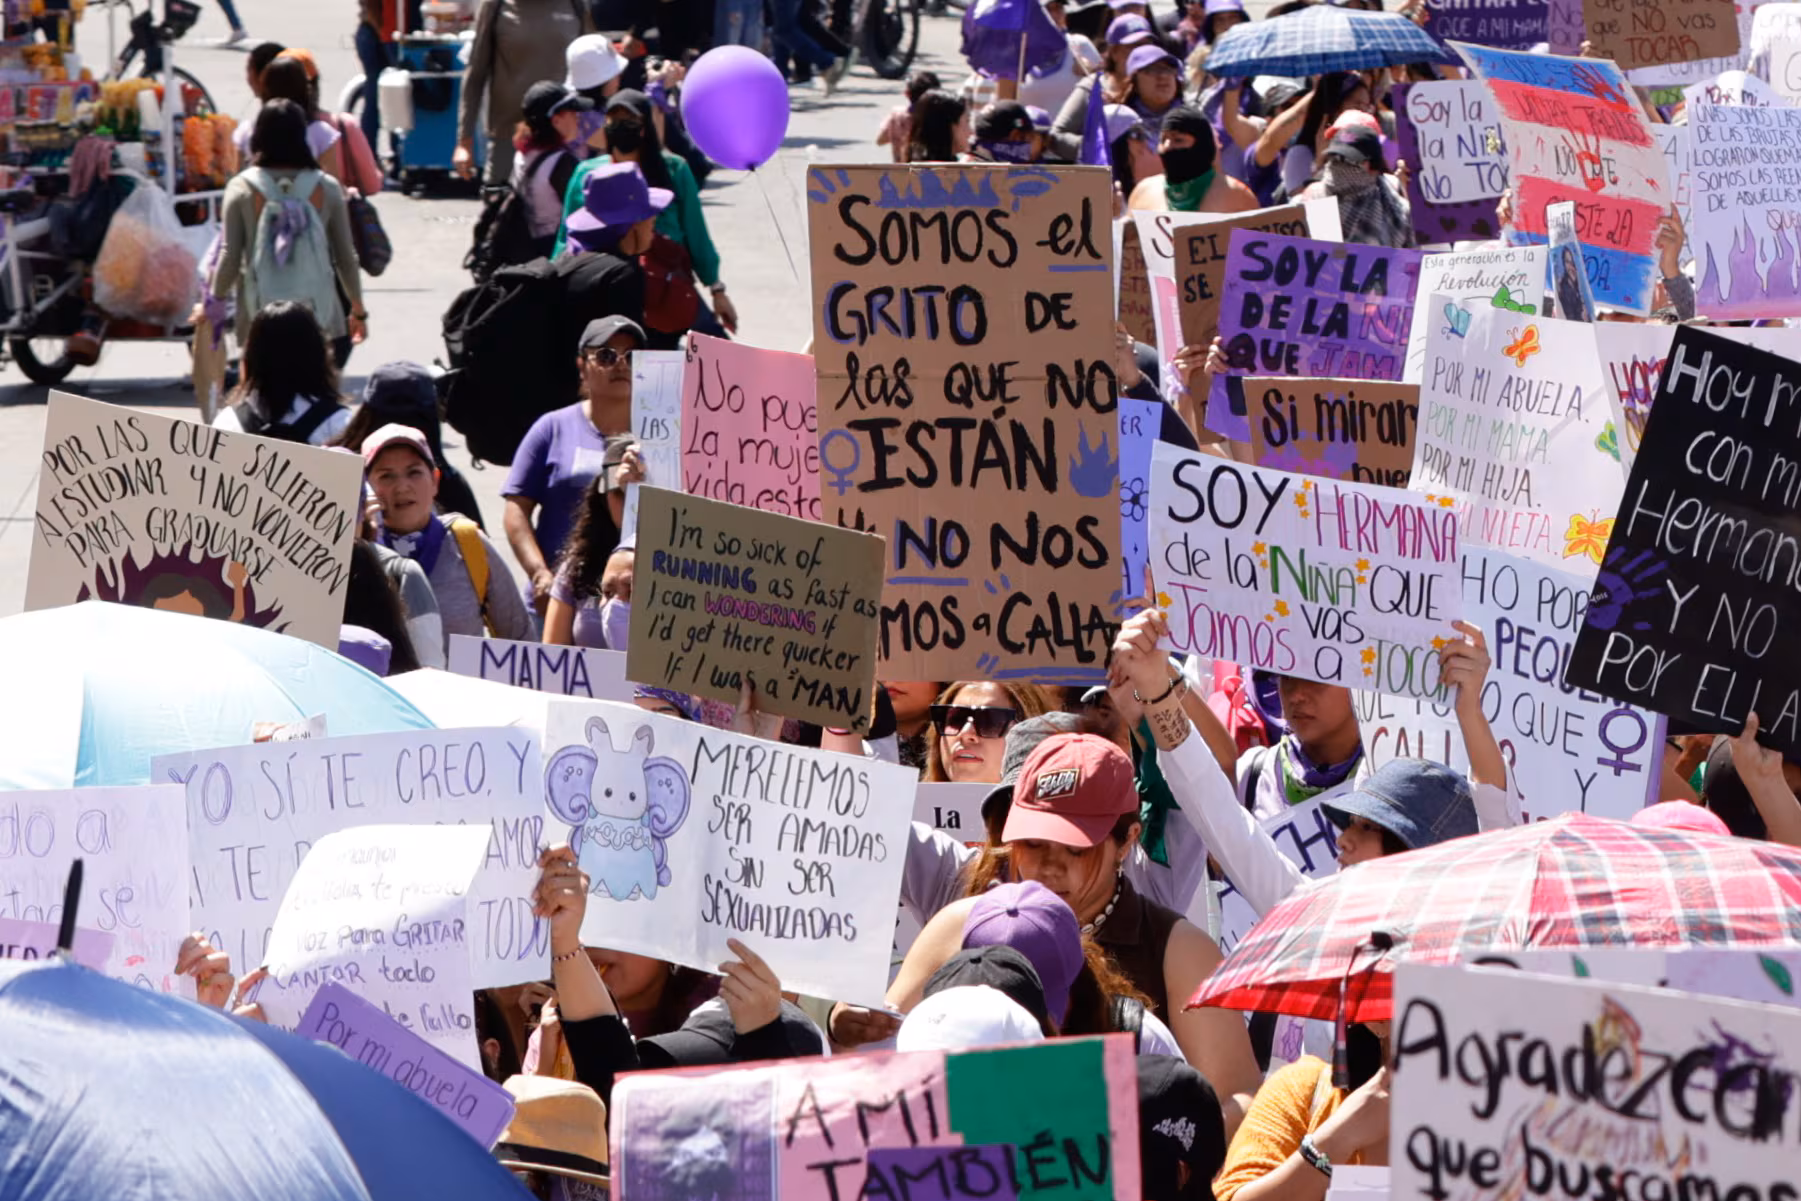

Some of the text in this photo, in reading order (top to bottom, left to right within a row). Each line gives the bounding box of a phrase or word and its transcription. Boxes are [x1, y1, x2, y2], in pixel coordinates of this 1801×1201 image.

[1632, 11, 1665, 33] NO
[1777, 111, 1801, 128] LAS
[1240, 239, 1388, 294] SOY LA
[826, 282, 1077, 345] GRITO DE
[944, 361, 1020, 408] QUE
[1047, 360, 1117, 413] NO
[1431, 356, 1463, 397] POR
[1471, 367, 1492, 403] MI
[43, 417, 351, 546] POR LAS QUE SALIERON
[1419, 443, 1449, 488] POR
[1456, 457, 1475, 493] MI
[1168, 458, 1458, 563] SOY HERMANA
[66, 507, 284, 585] PARA GRADUARSE
[653, 550, 757, 593] RUNNING
[796, 537, 824, 576] of
[1165, 533, 1211, 580] de
[1227, 538, 1258, 592] la
[1370, 567, 1443, 622] QUE
[321, 753, 364, 811] TE
[506, 740, 530, 794] Y
[708, 796, 887, 862] SER AMADAS
[934, 807, 960, 829] La
[788, 860, 834, 898] SER
[393, 915, 465, 948] GRITAR
[315, 1002, 479, 1121] Por mi abuela
